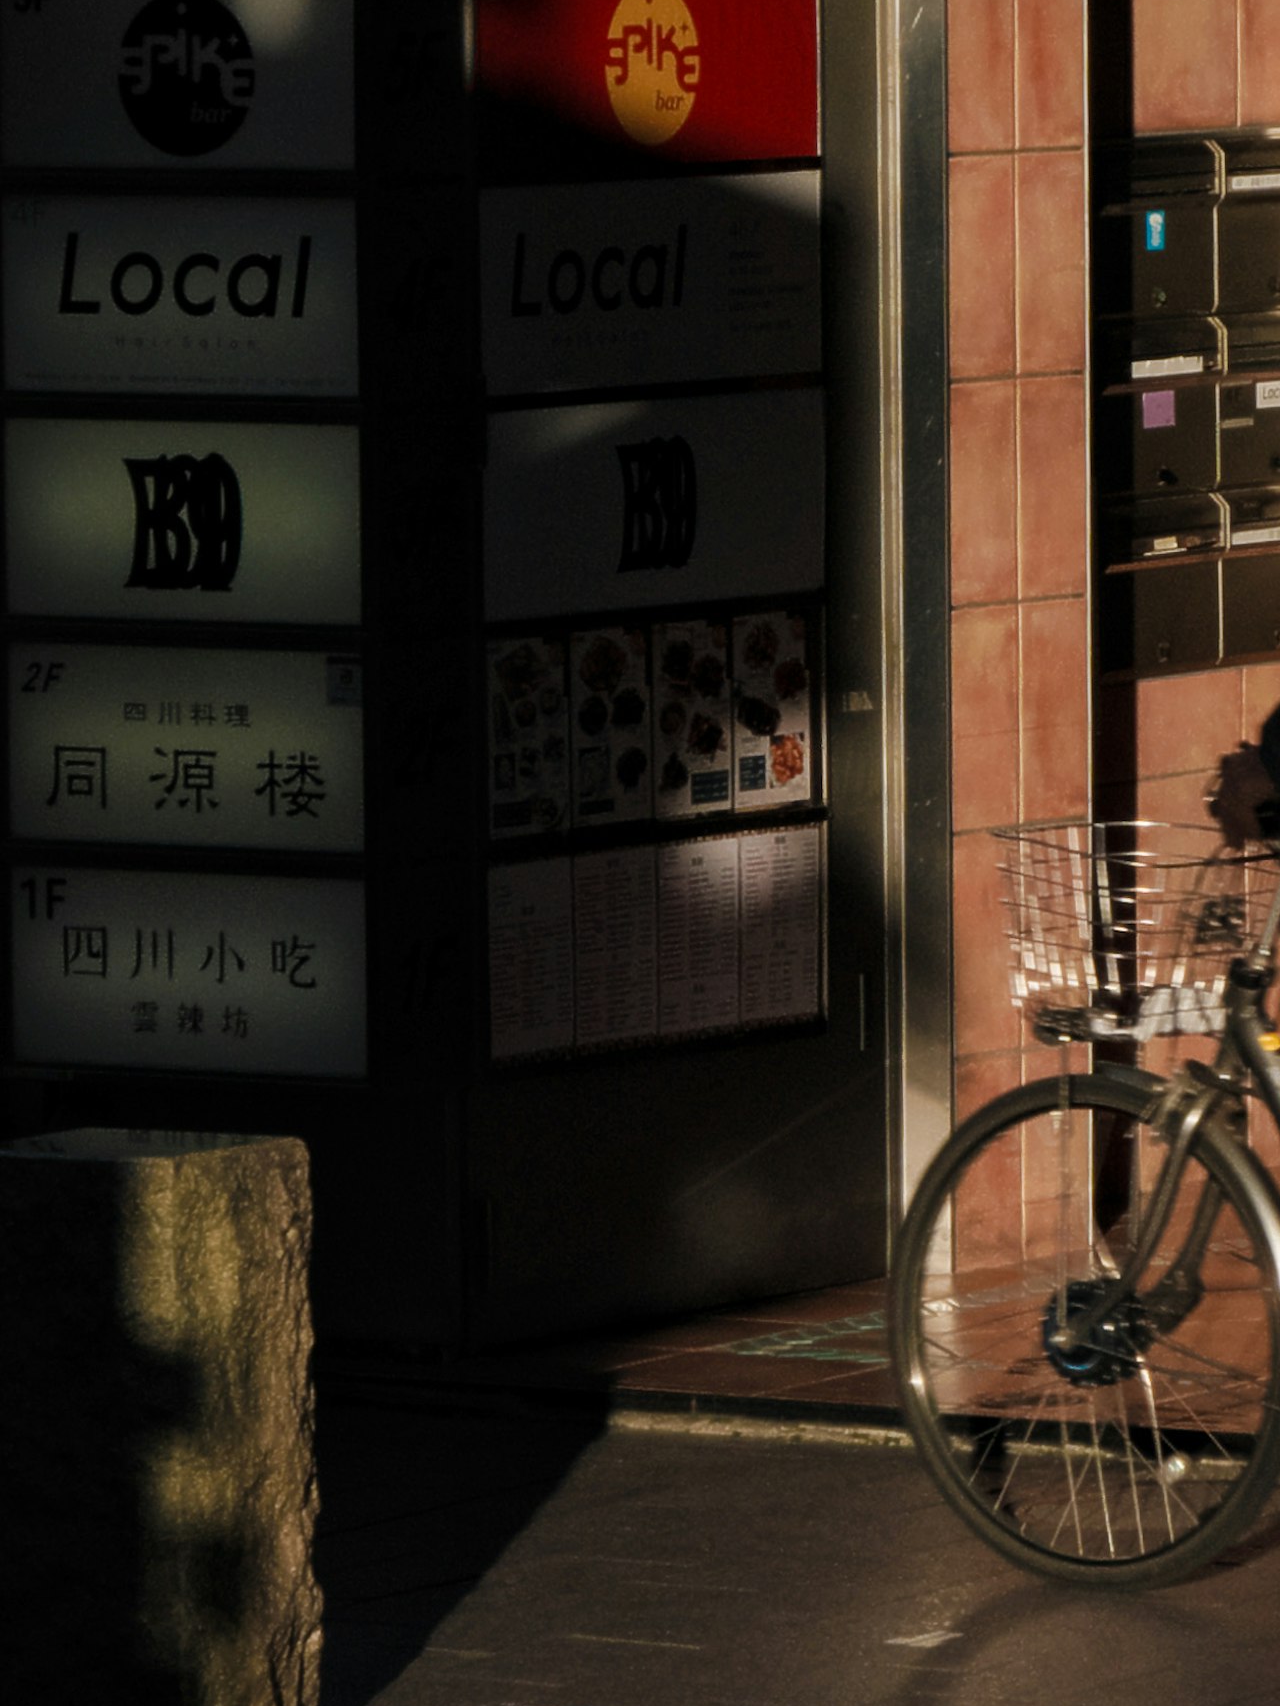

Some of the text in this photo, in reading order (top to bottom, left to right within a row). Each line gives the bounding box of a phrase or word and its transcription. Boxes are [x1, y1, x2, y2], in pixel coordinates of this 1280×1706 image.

[190, 99, 233, 124] bar
[655, 90, 685, 113] bar
[59, 232, 311, 318] Local
[511, 222, 688, 318] Local
[21, 661, 65, 694] 2F
[123, 701, 252, 728] 四川料理
[47, 745, 326, 818] 同源楼
[21, 877, 67, 922] 1F
[63, 924, 318, 990] 四川小吃
[130, 1000, 250, 1039] 雲辣坊
